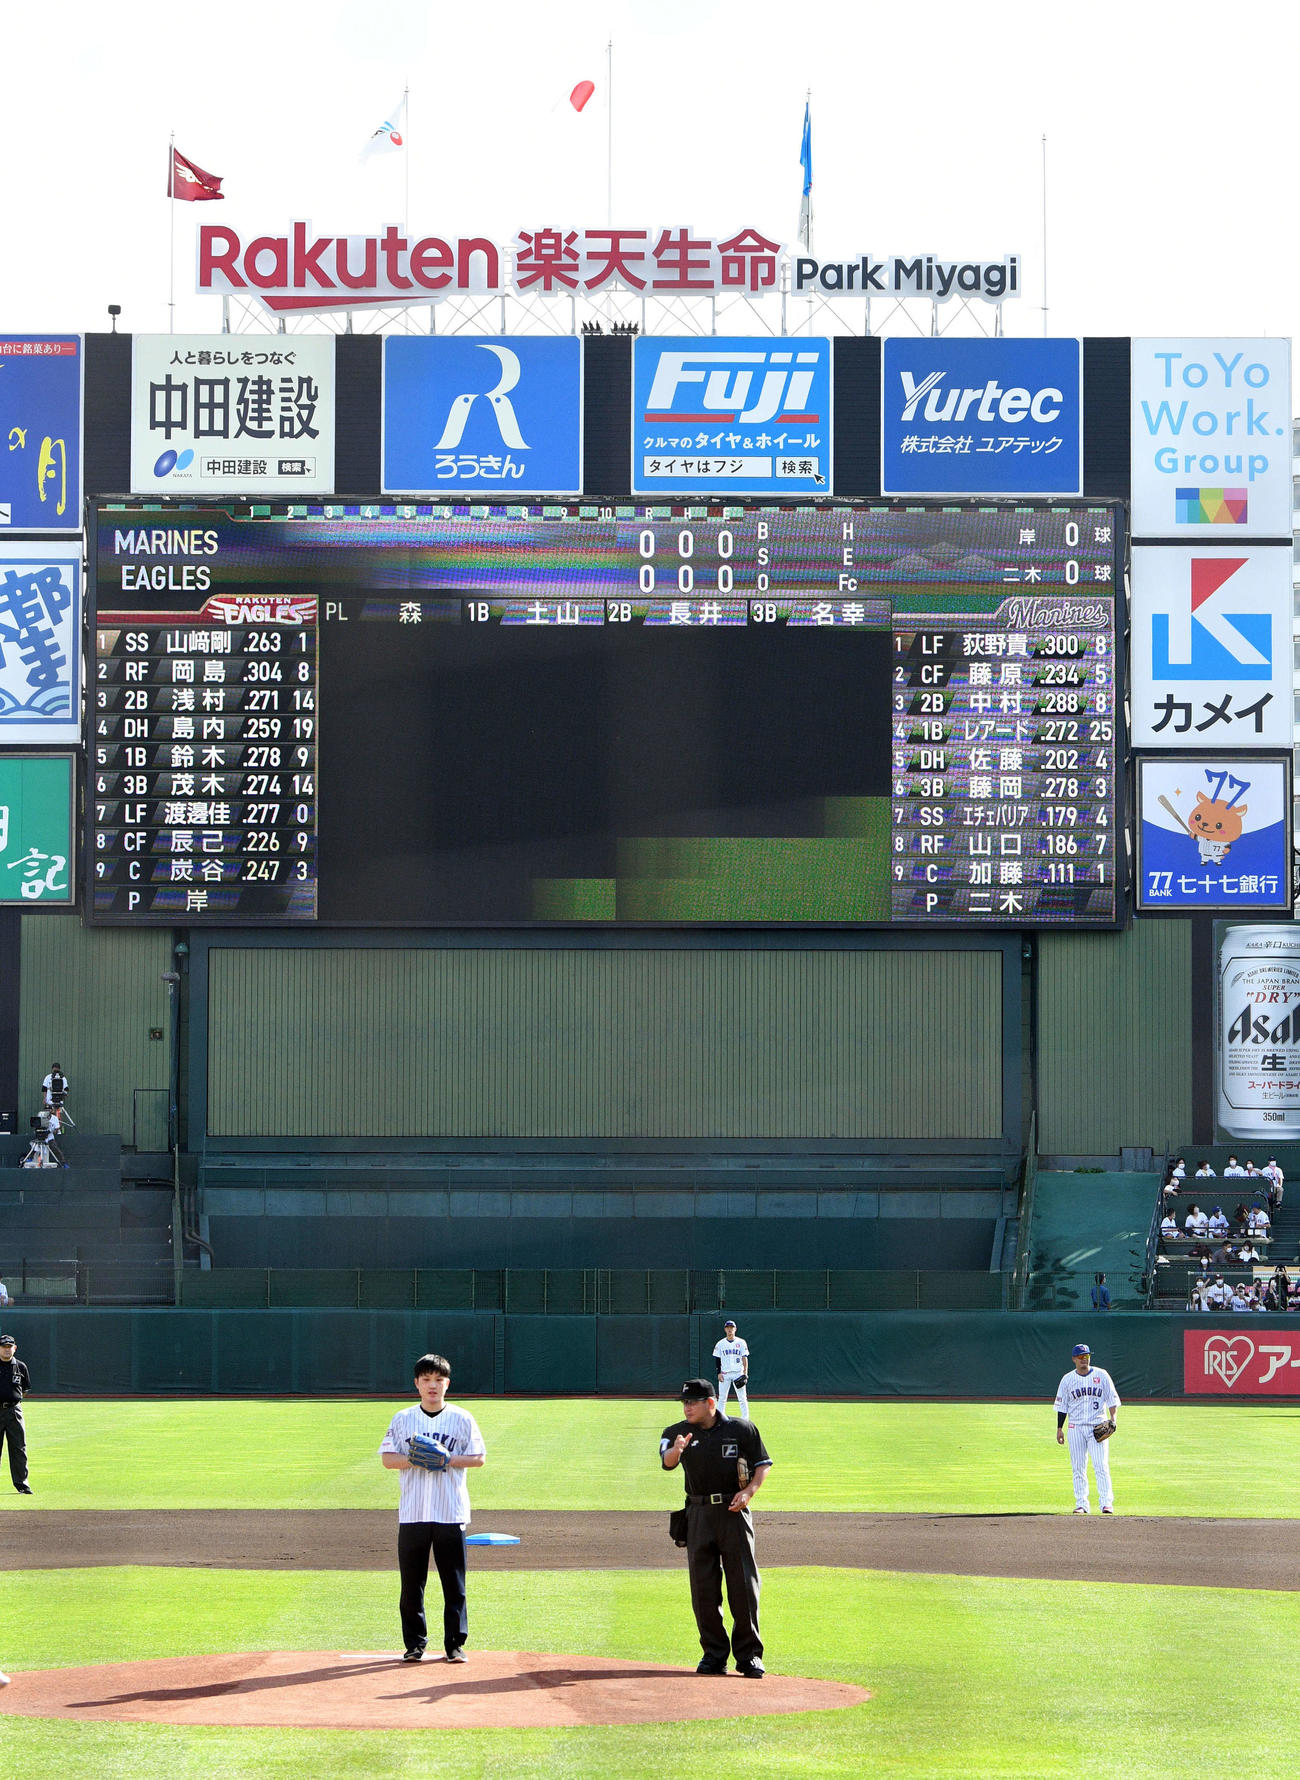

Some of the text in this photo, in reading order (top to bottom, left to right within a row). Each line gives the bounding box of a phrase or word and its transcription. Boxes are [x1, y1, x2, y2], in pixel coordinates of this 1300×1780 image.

[200, 222, 1016, 297] Rakuten 楽天生命 Park Miyagi
[0, 344, 61, 354] 台に銘菓あり
[170, 351, 296, 366] 人と暮らしをつなぐ
[1154, 353, 1270, 388] ToYo
[647, 352, 819, 424] Fuji
[900, 371, 1063, 423] Yurtec
[149, 374, 320, 440] 中田建設
[1141, 399, 1284, 436] Work.
[901, 436, 1063, 454] 株式会社 ユアテック
[206, 459, 302, 475] 中田建設 検索
[435, 454, 525, 479] ろうきん
[649, 459, 813, 474] タイヤはフジ 検索
[1154, 447, 1269, 481] Group
[757, 522, 768, 540] B
[843, 522, 853, 540] H
[1019, 522, 1112, 546] 岸 0 球
[114, 529, 733, 558] MARINES 0 0 0
[757, 548, 769, 565] S
[843, 548, 853, 566] E
[121, 565, 733, 593] EAGLES 0 0 0
[839, 574, 858, 592] Fc
[1003, 560, 1112, 585] 二木 0 球
[219, 603, 306, 625] EAGLES
[325, 601, 865, 625] PL 森 1B 土山 2B 長井 3B 名幸
[1007, 598, 1109, 629] Marines
[125, 632, 149, 652] SS
[243, 632, 281, 652] .263
[298, 632, 307, 652] 1
[922, 635, 943, 654] LF
[1040, 635, 1078, 655] .300
[1095, 635, 1107, 655] 8
[125, 660, 309, 683] RF 岡島 .304 8
[921, 663, 1106, 685] CF 藤原 .234 5
[124, 688, 314, 711] 2B 浅村 .271 14
[920, 691, 1107, 714] 2B 中村 .288 8
[1151, 692, 1274, 733] カメイ
[124, 716, 313, 739] DH 島内 .259 19
[921, 720, 1112, 742] 1B レアード .272 25
[125, 745, 308, 768] 1B 鈴木 .278 9
[920, 748, 1108, 771] DH 佐藤 .202 4
[124, 773, 314, 796] 3B 茂木 .274 14
[920, 776, 1107, 799] 3B 藤岡 .278 3
[1204, 768, 1251, 810] 77
[124, 804, 147, 823] LF
[242, 804, 280, 824] .277
[297, 804, 308, 823] 0
[920, 806, 944, 826] SS
[1041, 806, 1077, 826] .179
[1095, 806, 1108, 826] 4
[124, 830, 308, 853] CF 辰己 .226 9
[921, 833, 1107, 855] RF 山口 .186 7
[129, 859, 307, 881] C 炭谷 .247 3
[926, 861, 1105, 884] C 加藤 .111 1
[1148, 871, 1174, 889] 77
[1149, 889, 1173, 897] BANK
[1177, 874, 1279, 894] 七十七銀行
[128, 890, 208, 912] P 岸
[926, 891, 1023, 913] P 二木
[1261, 1053, 1287, 1072] 生
[1263, 1112, 1285, 1122] 350ml
[1204, 1345, 1300, 1384] IRIS ア
[1070, 1386, 1103, 1400] TOHOKU
[1093, 1401, 1099, 1410] 3
